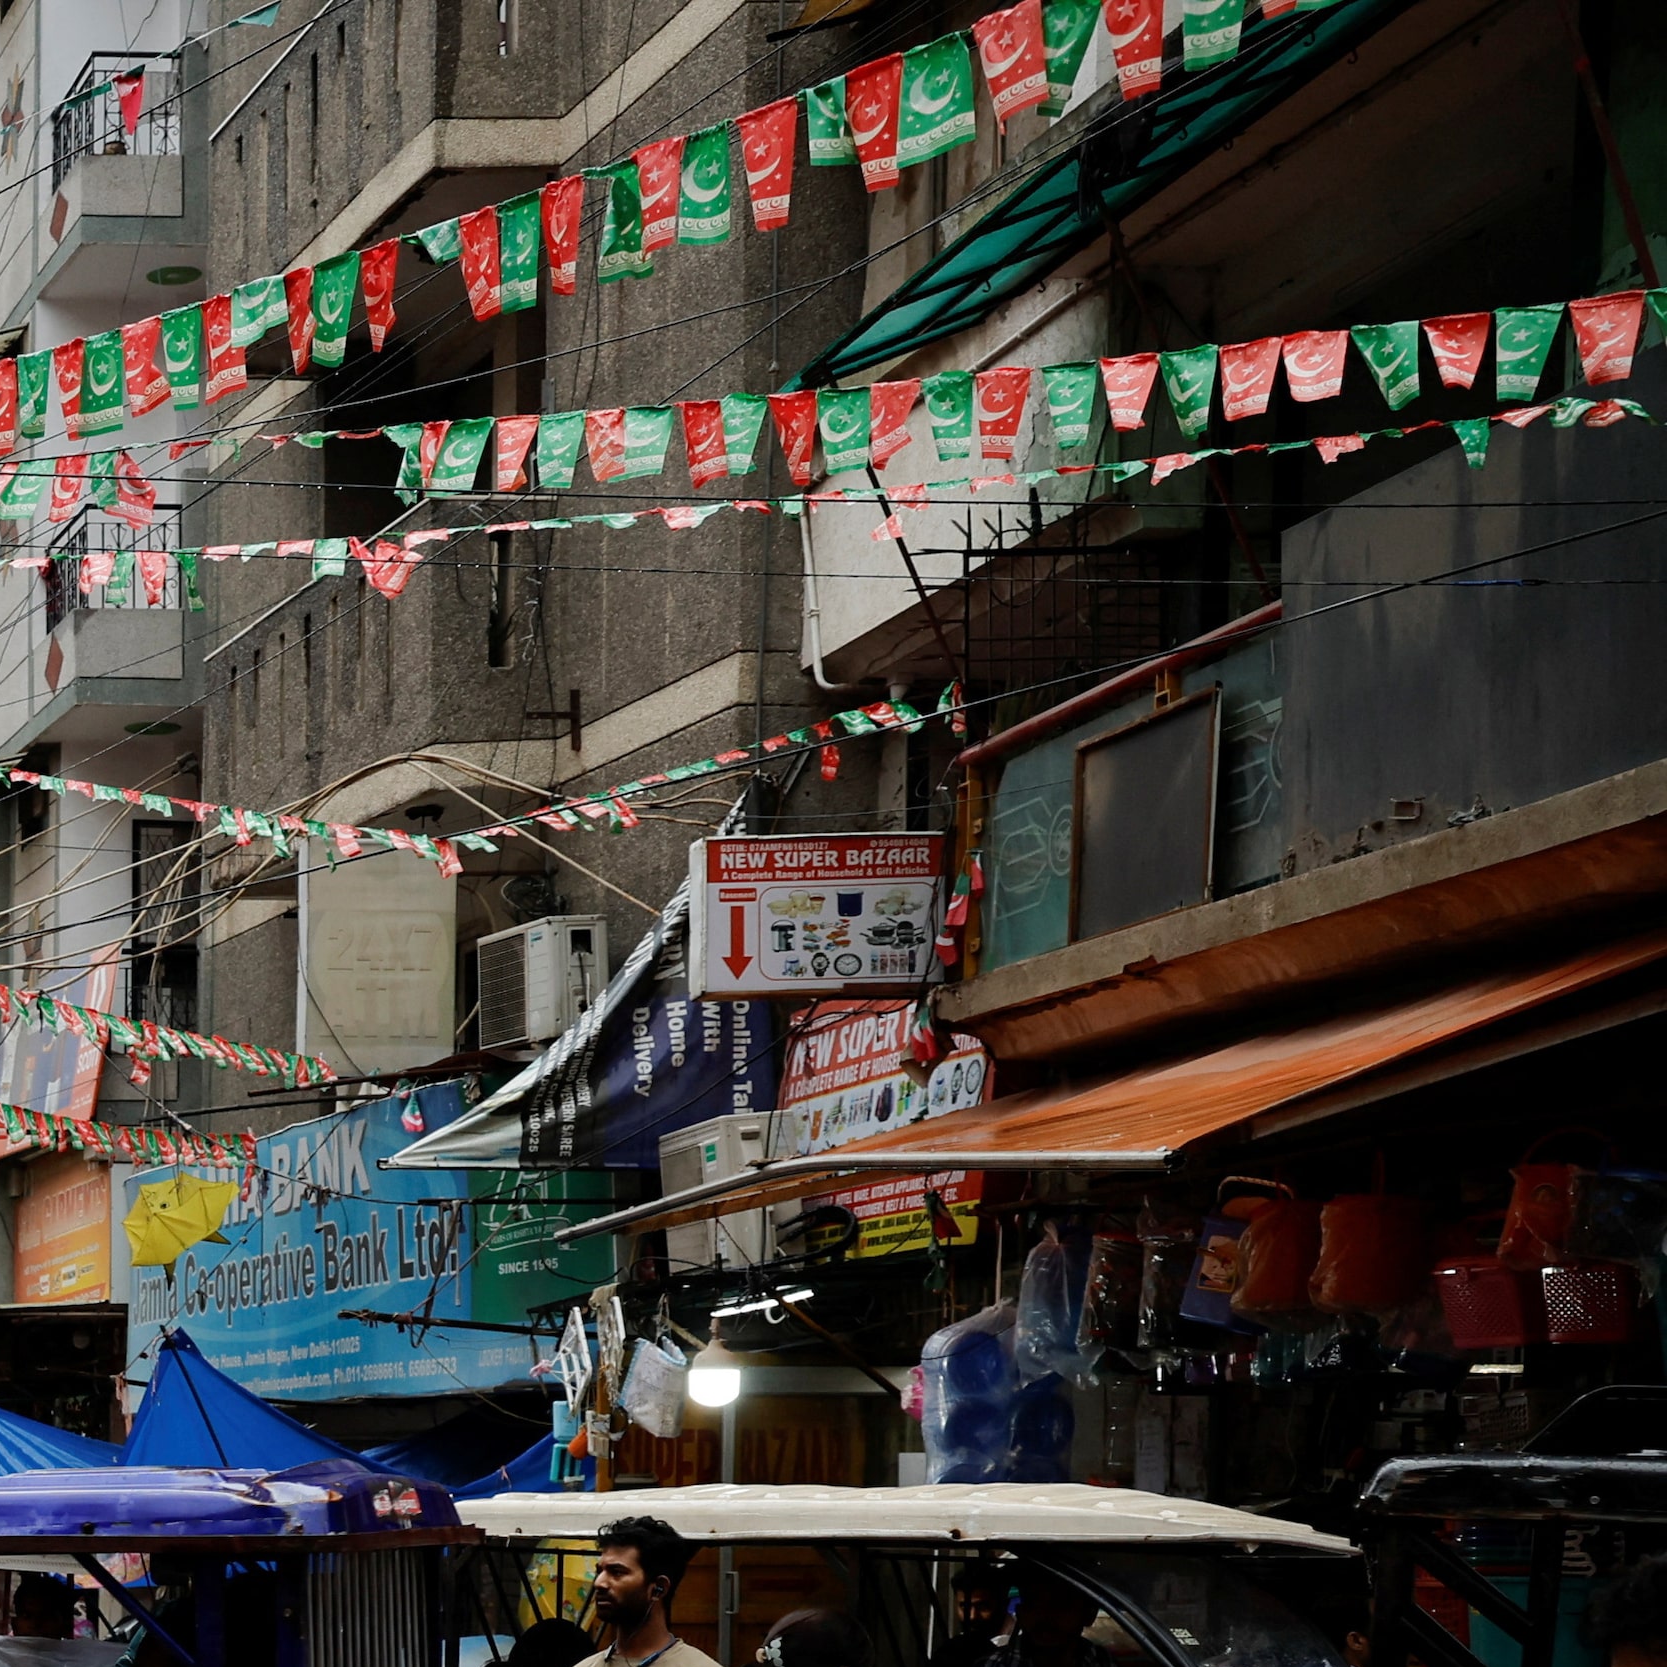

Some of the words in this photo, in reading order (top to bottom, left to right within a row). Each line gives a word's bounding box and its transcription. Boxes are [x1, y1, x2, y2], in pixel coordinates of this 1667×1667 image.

[719, 852, 767, 869] NEW
[774, 850, 839, 868] SUPER
[845, 847, 931, 866] BAZAAR
[722, 871, 729, 880] A
[730, 870, 773, 881] Complete
[774, 869, 805, 881] Range
[805, 868, 816, 879] of
[817, 867, 864, 879] Household
[866, 868, 874, 877] &
[875, 865, 894, 877] Gift
[893, 864, 931, 876] Articles
[719, 890, 757, 900] Basement
[666, 1000, 688, 1068] Home
[701, 1000, 721, 1053] With
[631, 1006, 655, 1097] Delivery
[791, 1030, 837, 1078] NEW
[837, 1010, 902, 1063] SUPER
[833, 1065, 858, 1087] RANGE
[858, 1063, 872, 1080] OF
[733, 1080, 755, 1114] Tai
[558, 1124, 575, 1158] SAREE
[270, 1119, 372, 1217] BANK
[132, 1266, 180, 1328] Jamia
[183, 1233, 316, 1328] Co-operative
[321, 1211, 391, 1295] Bank
[498, 1259, 530, 1276] SINCE
[532, 1257, 560, 1272] 1995
[290, 1343, 309, 1362] New
